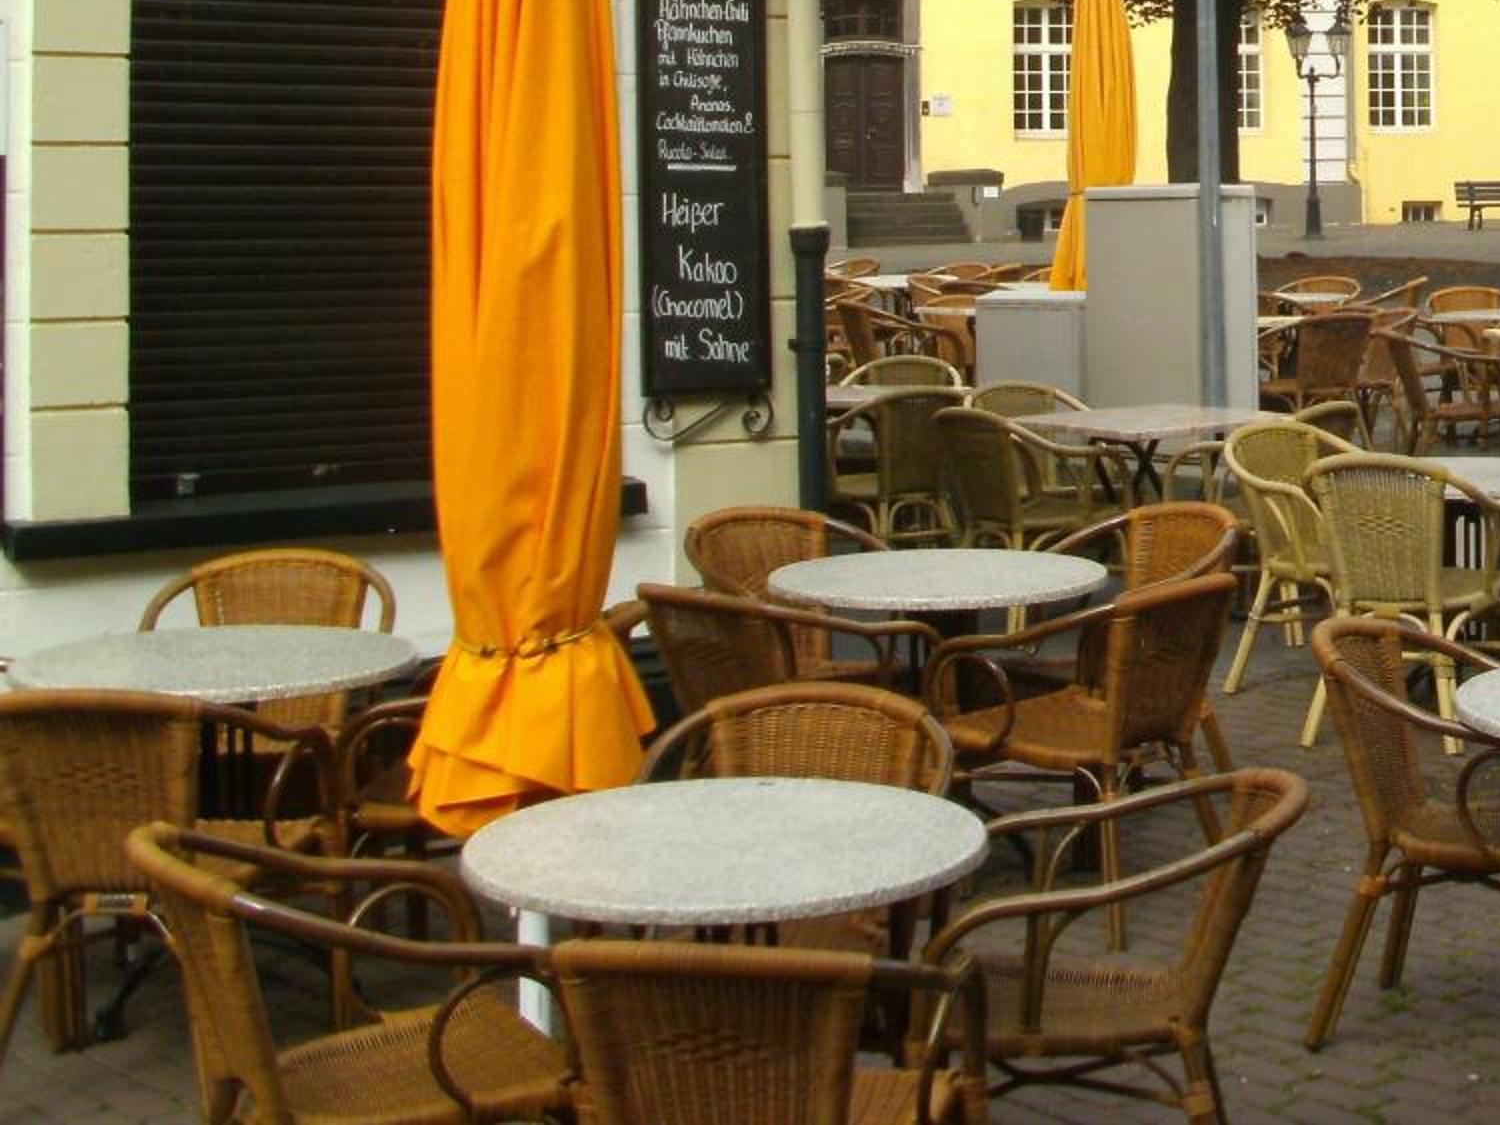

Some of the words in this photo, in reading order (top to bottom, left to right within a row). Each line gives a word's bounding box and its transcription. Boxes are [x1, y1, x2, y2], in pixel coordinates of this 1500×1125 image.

[654, 19, 733, 50] Pfannkuchen
[662, 192, 725, 233] Heißer
[678, 245, 737, 284] Kakao
[665, 334, 691, 361] mit
[699, 328, 750, 363] Sahne
